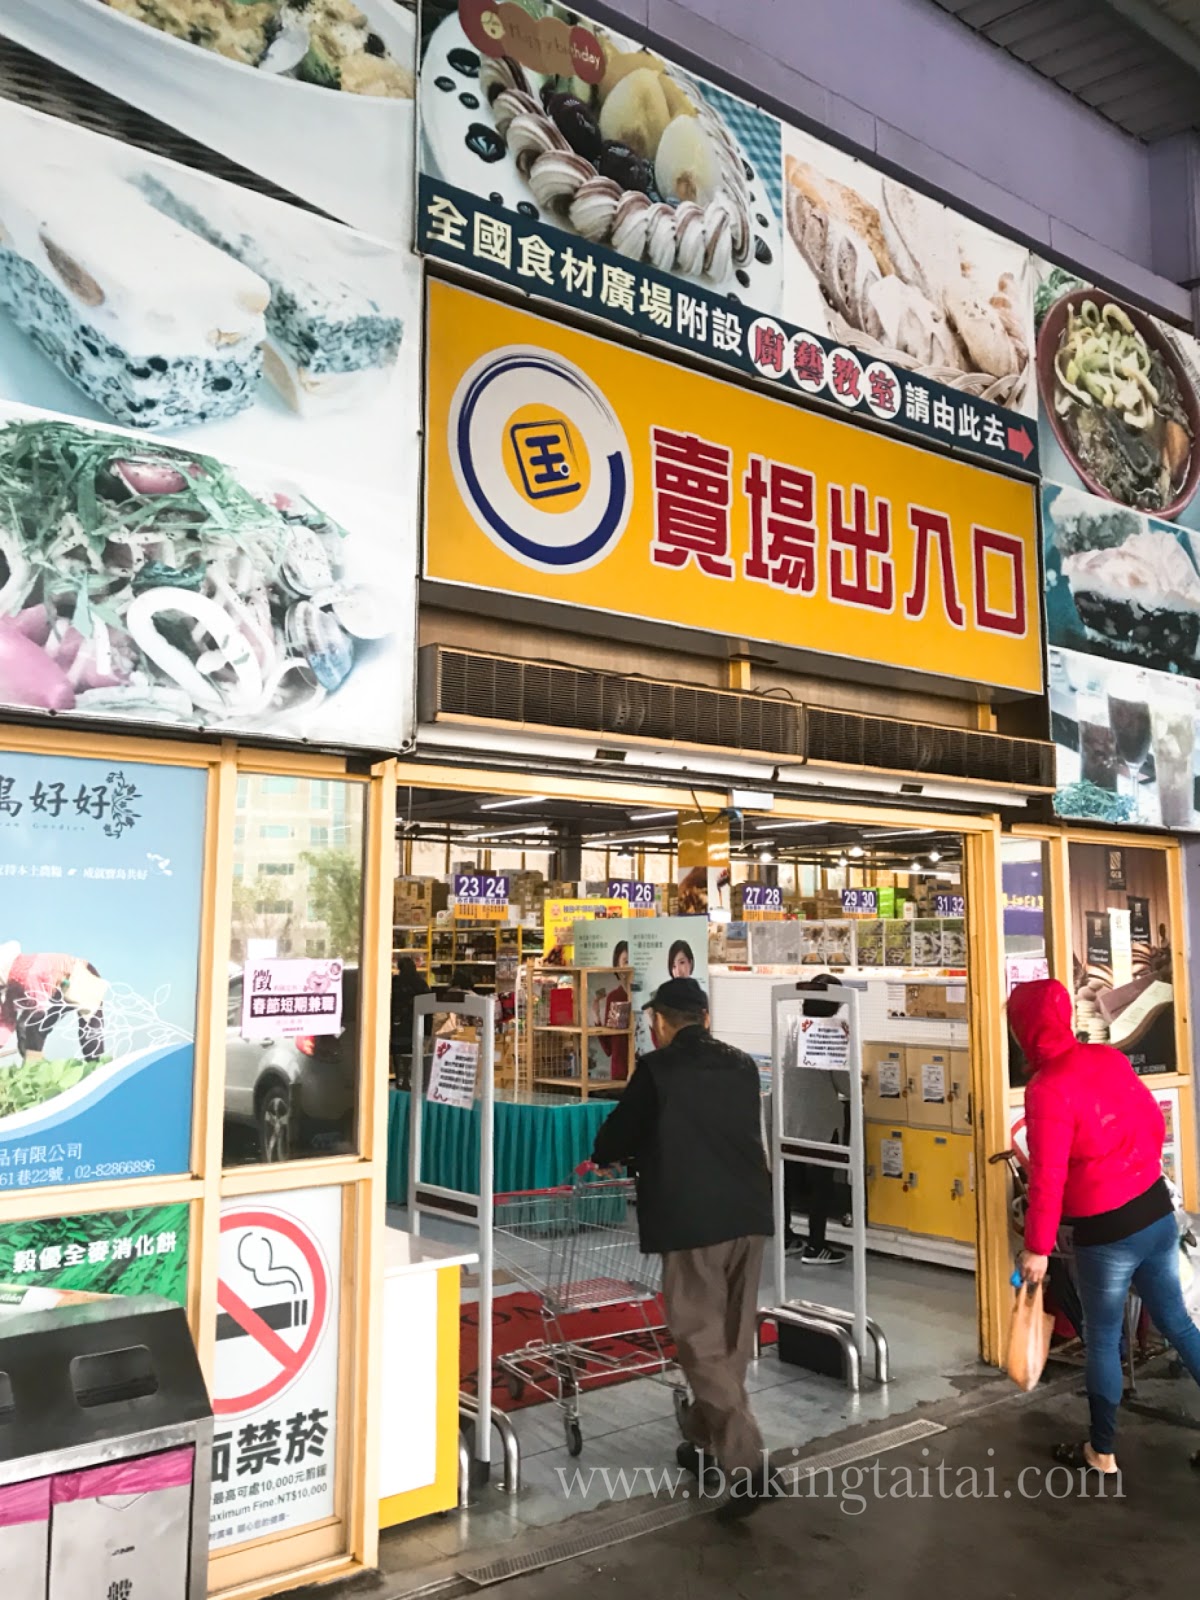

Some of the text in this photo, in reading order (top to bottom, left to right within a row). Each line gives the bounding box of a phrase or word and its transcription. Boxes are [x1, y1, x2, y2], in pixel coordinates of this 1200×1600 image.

[650, 424, 1027, 638] 賣場出入口
[459, 876, 480, 897] 23
[486, 878, 506, 898] 24
[612, 883, 630, 900] 25
[635, 884, 652, 902] 26
[745, 887, 761, 905] 27
[765, 889, 780, 905] 28
[844, 891, 858, 906] 29
[862, 891, 875, 907] 30
[937, 896, 948, 912] 31
[952, 897, 964, 912] 32
[0, 1143, 82, 1167] 品有限公司
[209, 1504, 251, 1522] aximum
